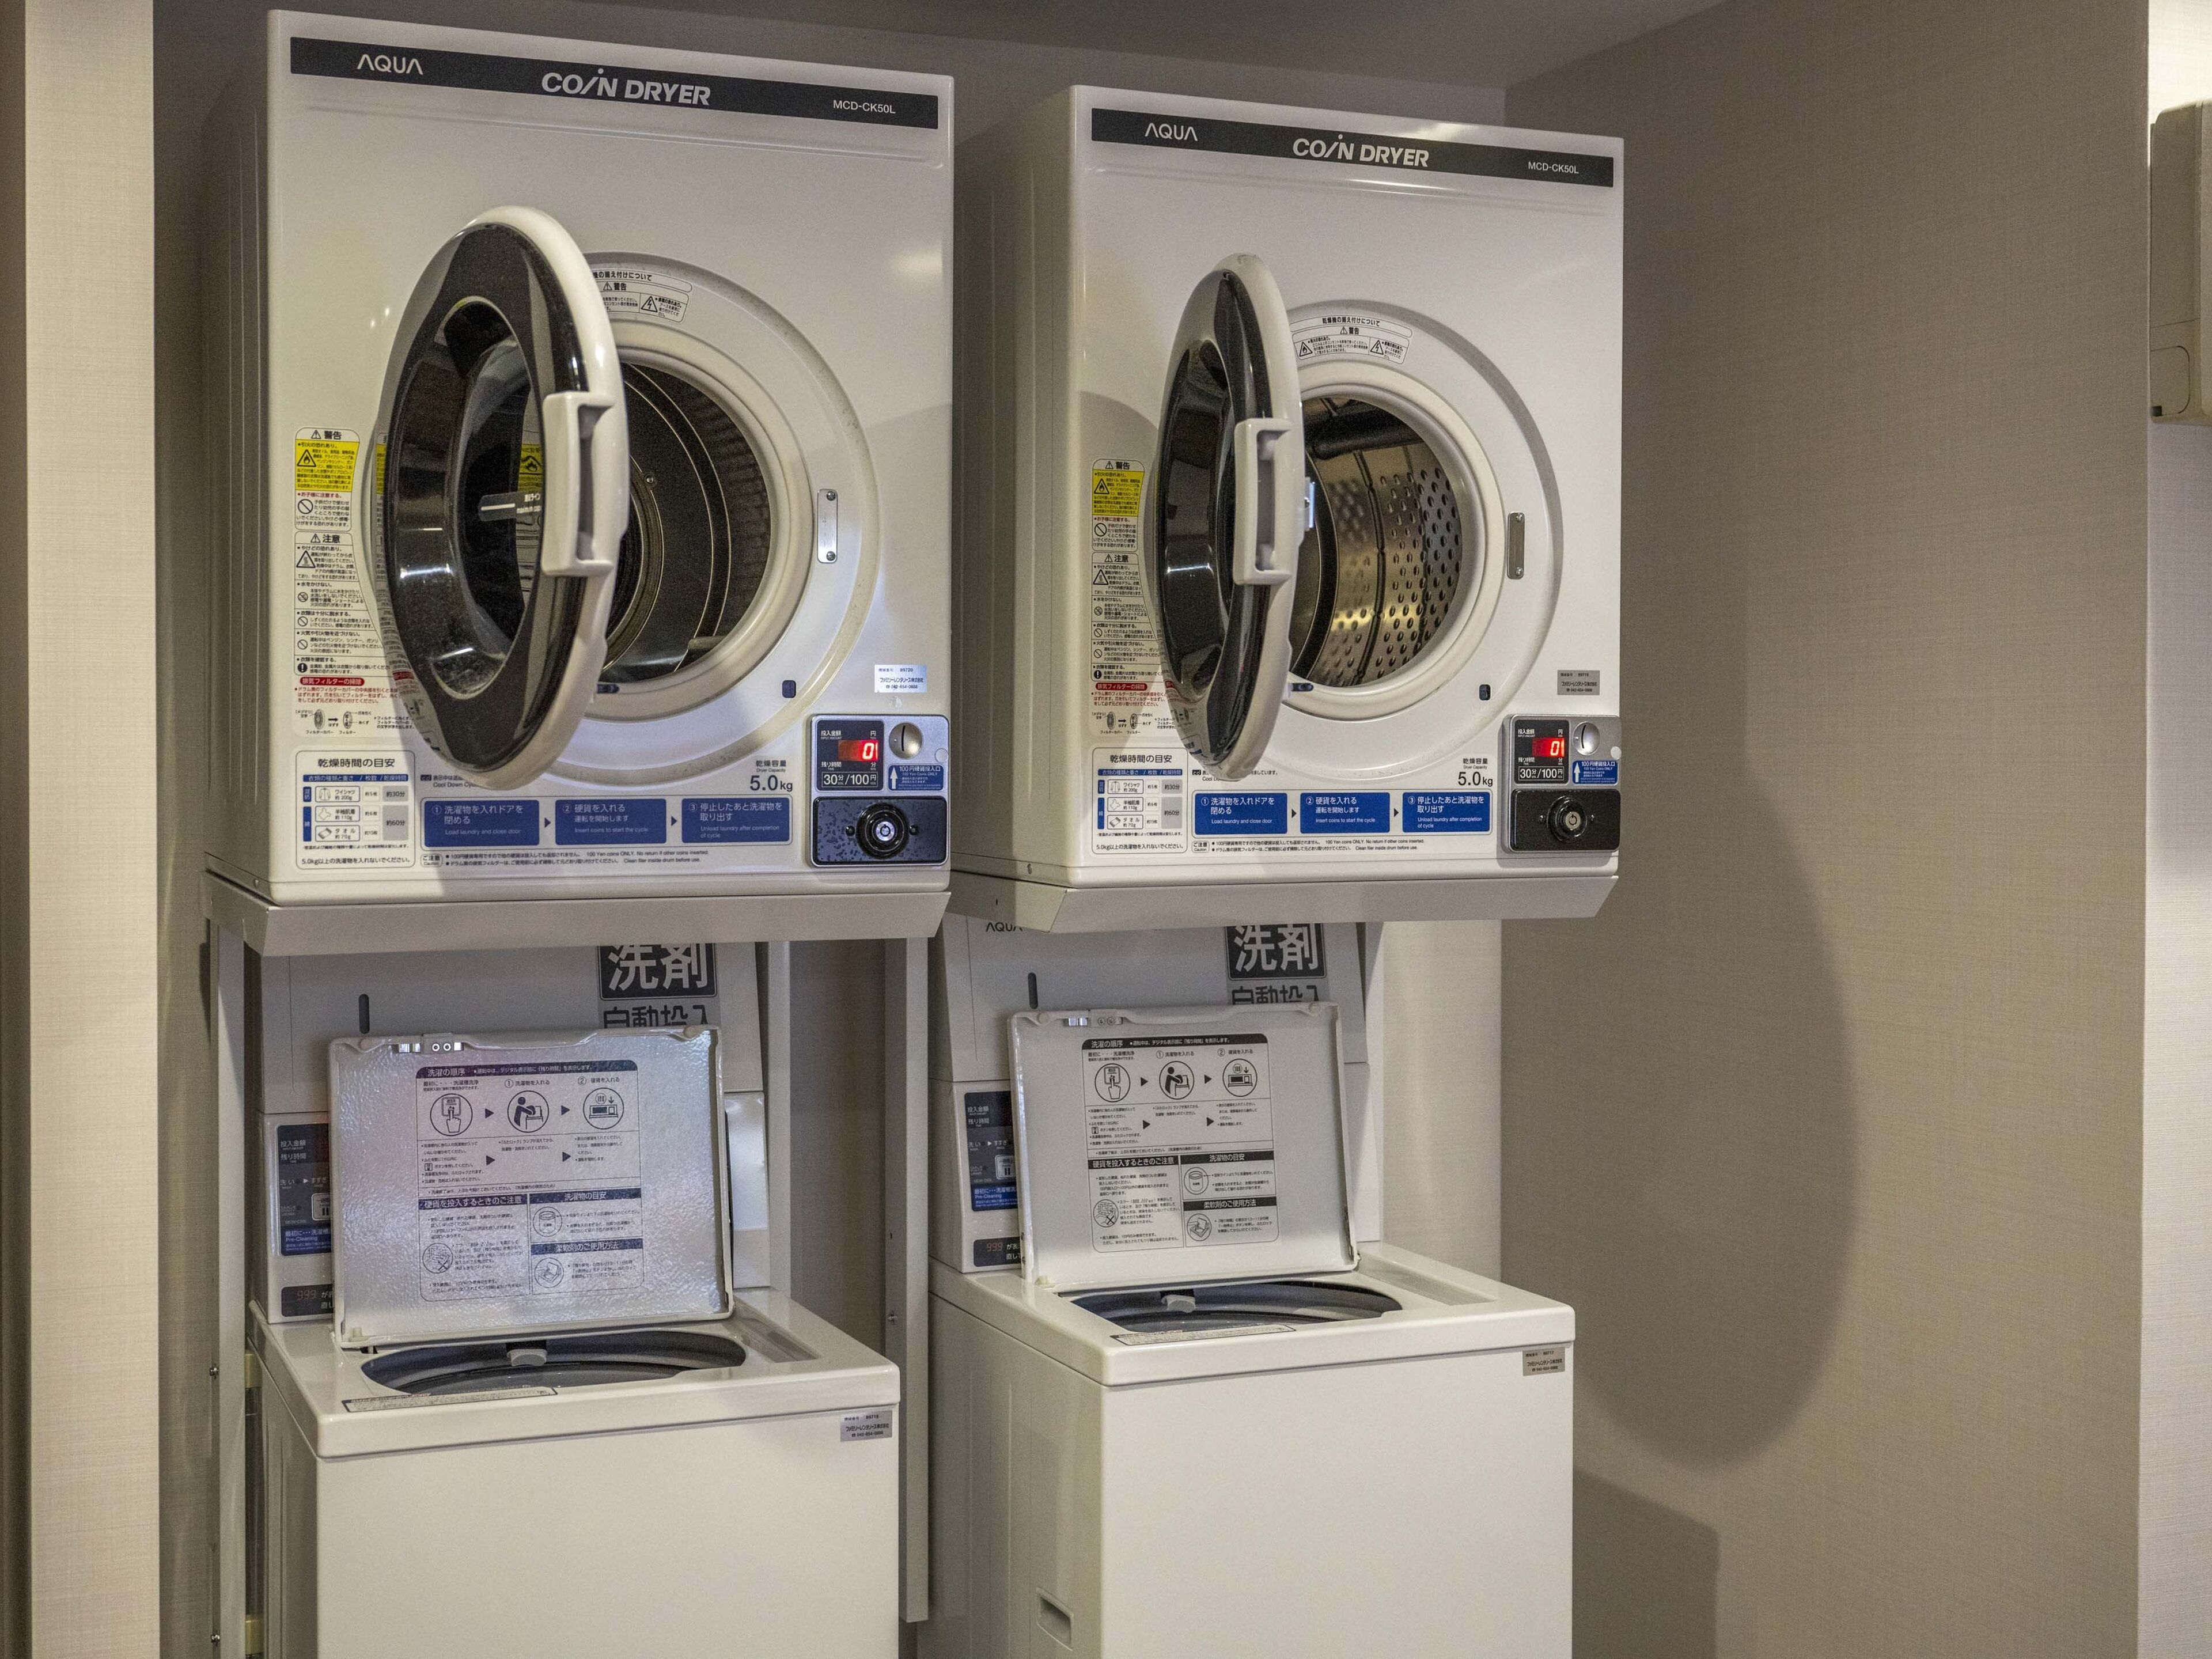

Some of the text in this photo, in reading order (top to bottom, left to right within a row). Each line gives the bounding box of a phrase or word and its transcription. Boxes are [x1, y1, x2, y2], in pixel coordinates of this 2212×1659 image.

[357, 54, 424, 76] AQUA
[541, 67, 711, 106] COIN DRYER
[832, 99, 896, 114] MCD-CK50L
[1145, 122, 1198, 142] AQUA
[1292, 134, 1429, 167] COIN DRYER
[1527, 161, 1580, 175] MCD-CK50L
[613, 282, 627, 290] 警告
[324, 430, 342, 440] 警告
[1115, 461, 1130, 470] 警告
[322, 534, 340, 544] 注意
[1113, 554, 1129, 563] 注意
[317, 757, 396, 768] 乾燥時間の目安
[1109, 755, 1172, 763] 乾燥時間の目安
[1210, 797, 1275, 805] 洗濯物を入れドアを
[1315, 797, 1357, 805] 硬貨を入れる
[1417, 796, 1484, 805] 停止したあと洗濯物を
[444, 804, 524, 815] 洗濯物を入れドアを
[574, 804, 626, 813] 硬貨を入れる
[700, 802, 783, 812] 停止したあと洗濯物を
[1210, 806, 1232, 815] 閉める
[1416, 805, 1444, 813] 取り出す
[444, 815, 471, 825] 閉める
[574, 815, 629, 823] 運転を開始します
[699, 812, 733, 822] 取り出す
[1234, 923, 1318, 972] 洗剤
[608, 942, 709, 991] 洗剤
[1091, 1040, 1123, 1048] 洗濯の順序
[427, 1068, 465, 1077] 洗濯の順序
[1092, 1157, 1175, 1168] 硬貨を投入するときのご注意
[1209, 1153, 1245, 1162] 洗濯物の目安
[564, 1191, 607, 1201] 洗濯物の目安
[424, 1195, 522, 1209] 硬貨を投入するときのご注意
[1203, 1199, 1257, 1209] 柔軟剤のご使用方法
